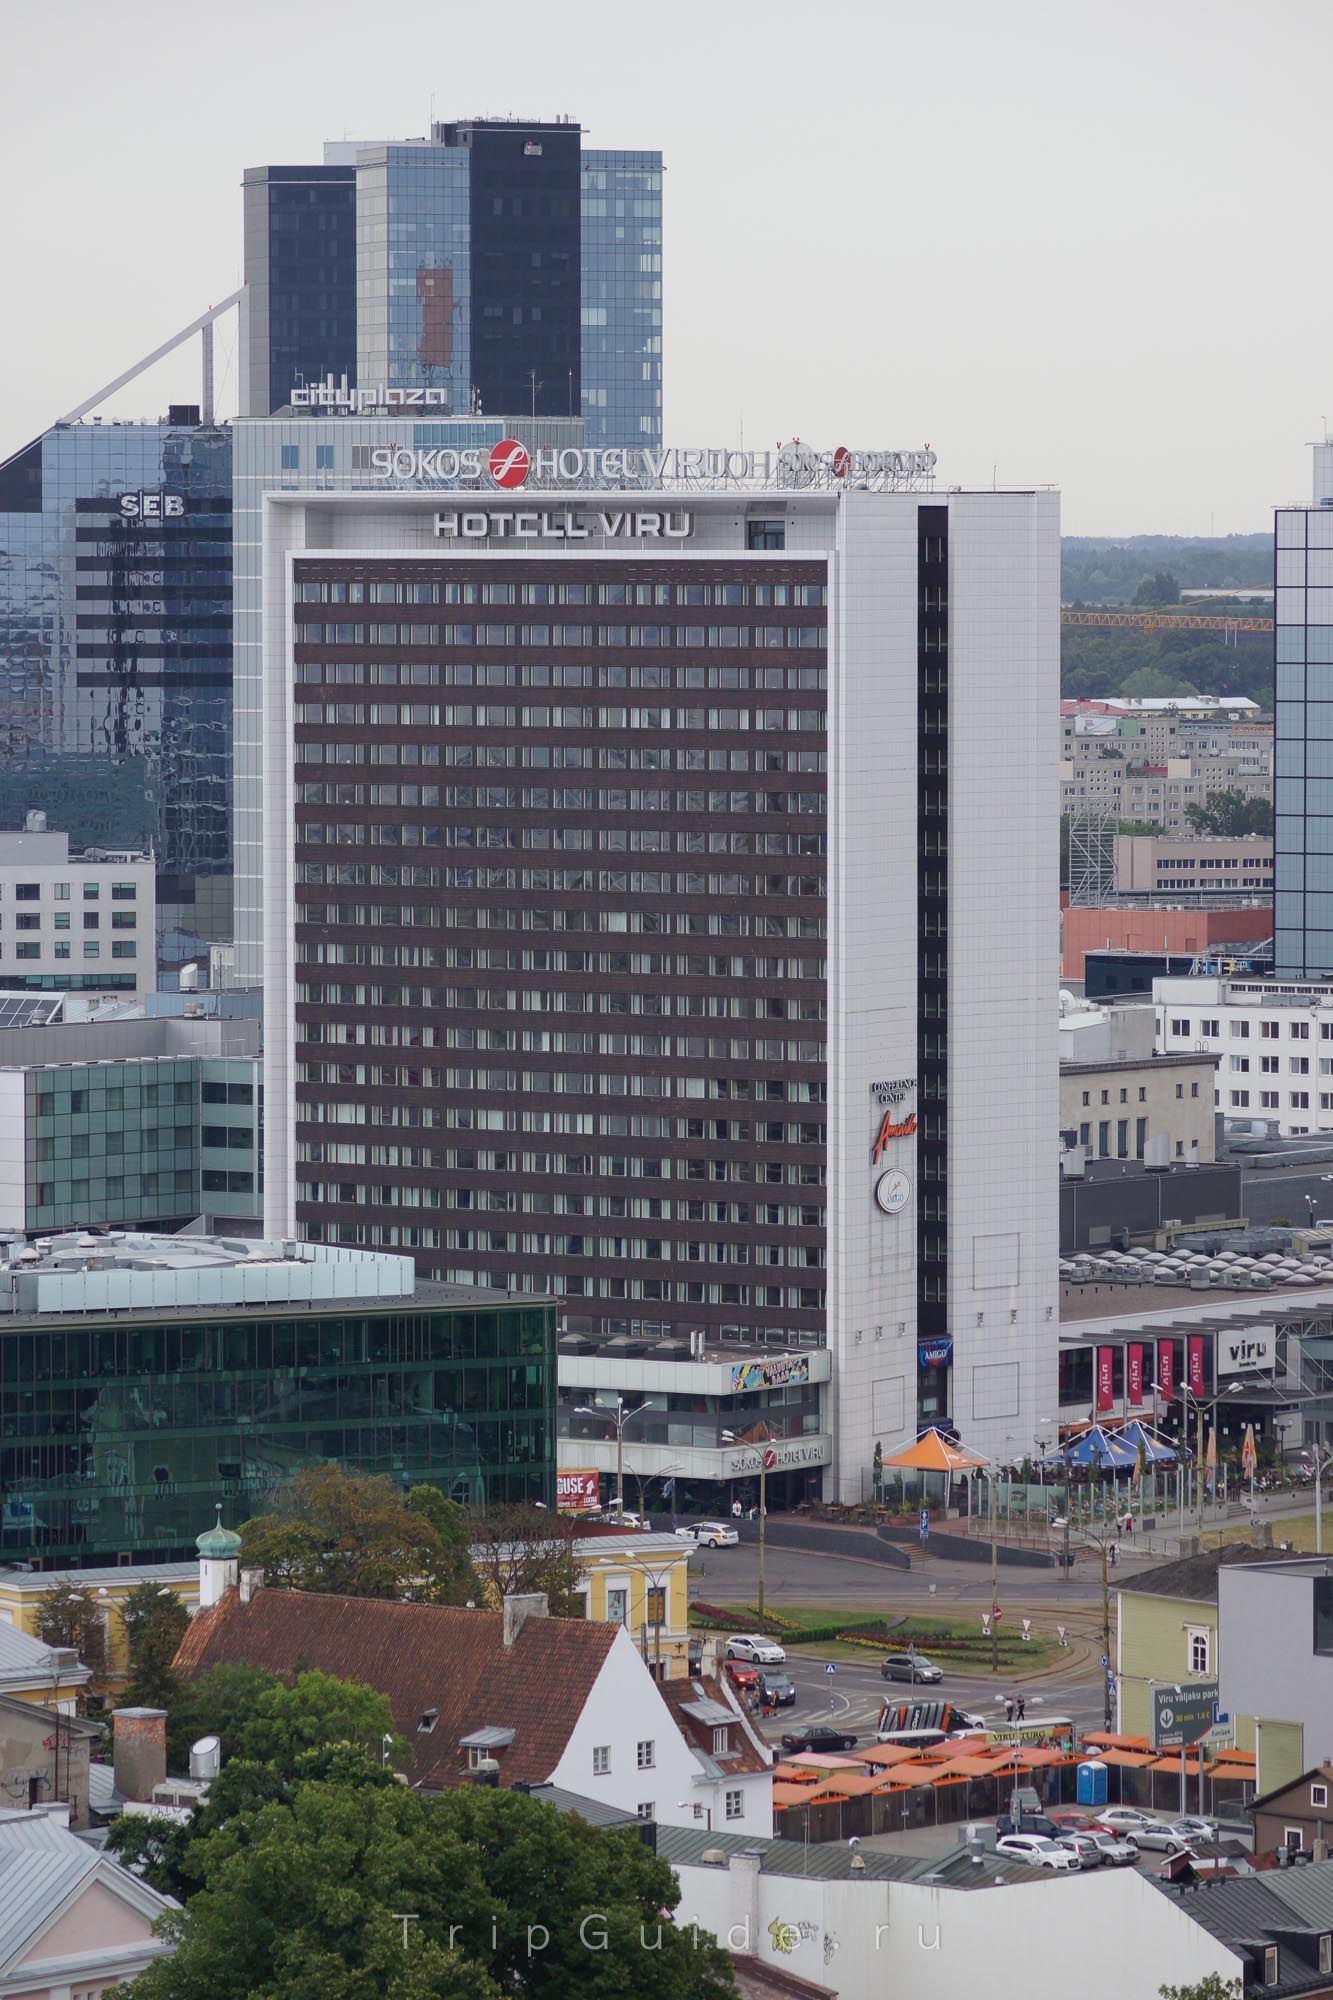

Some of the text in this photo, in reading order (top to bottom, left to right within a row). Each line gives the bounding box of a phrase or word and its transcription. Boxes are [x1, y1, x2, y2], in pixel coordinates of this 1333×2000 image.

[371, 448, 483, 480] SOKOS
[536, 448, 640, 480] HOTEL
[642, 447, 728, 480] VIRU
[120, 493, 185, 518] SEB
[598, 512, 696, 537] VIRU
[924, 1349, 947, 1361] AMIGO
[1229, 1339, 1267, 1361] viru
